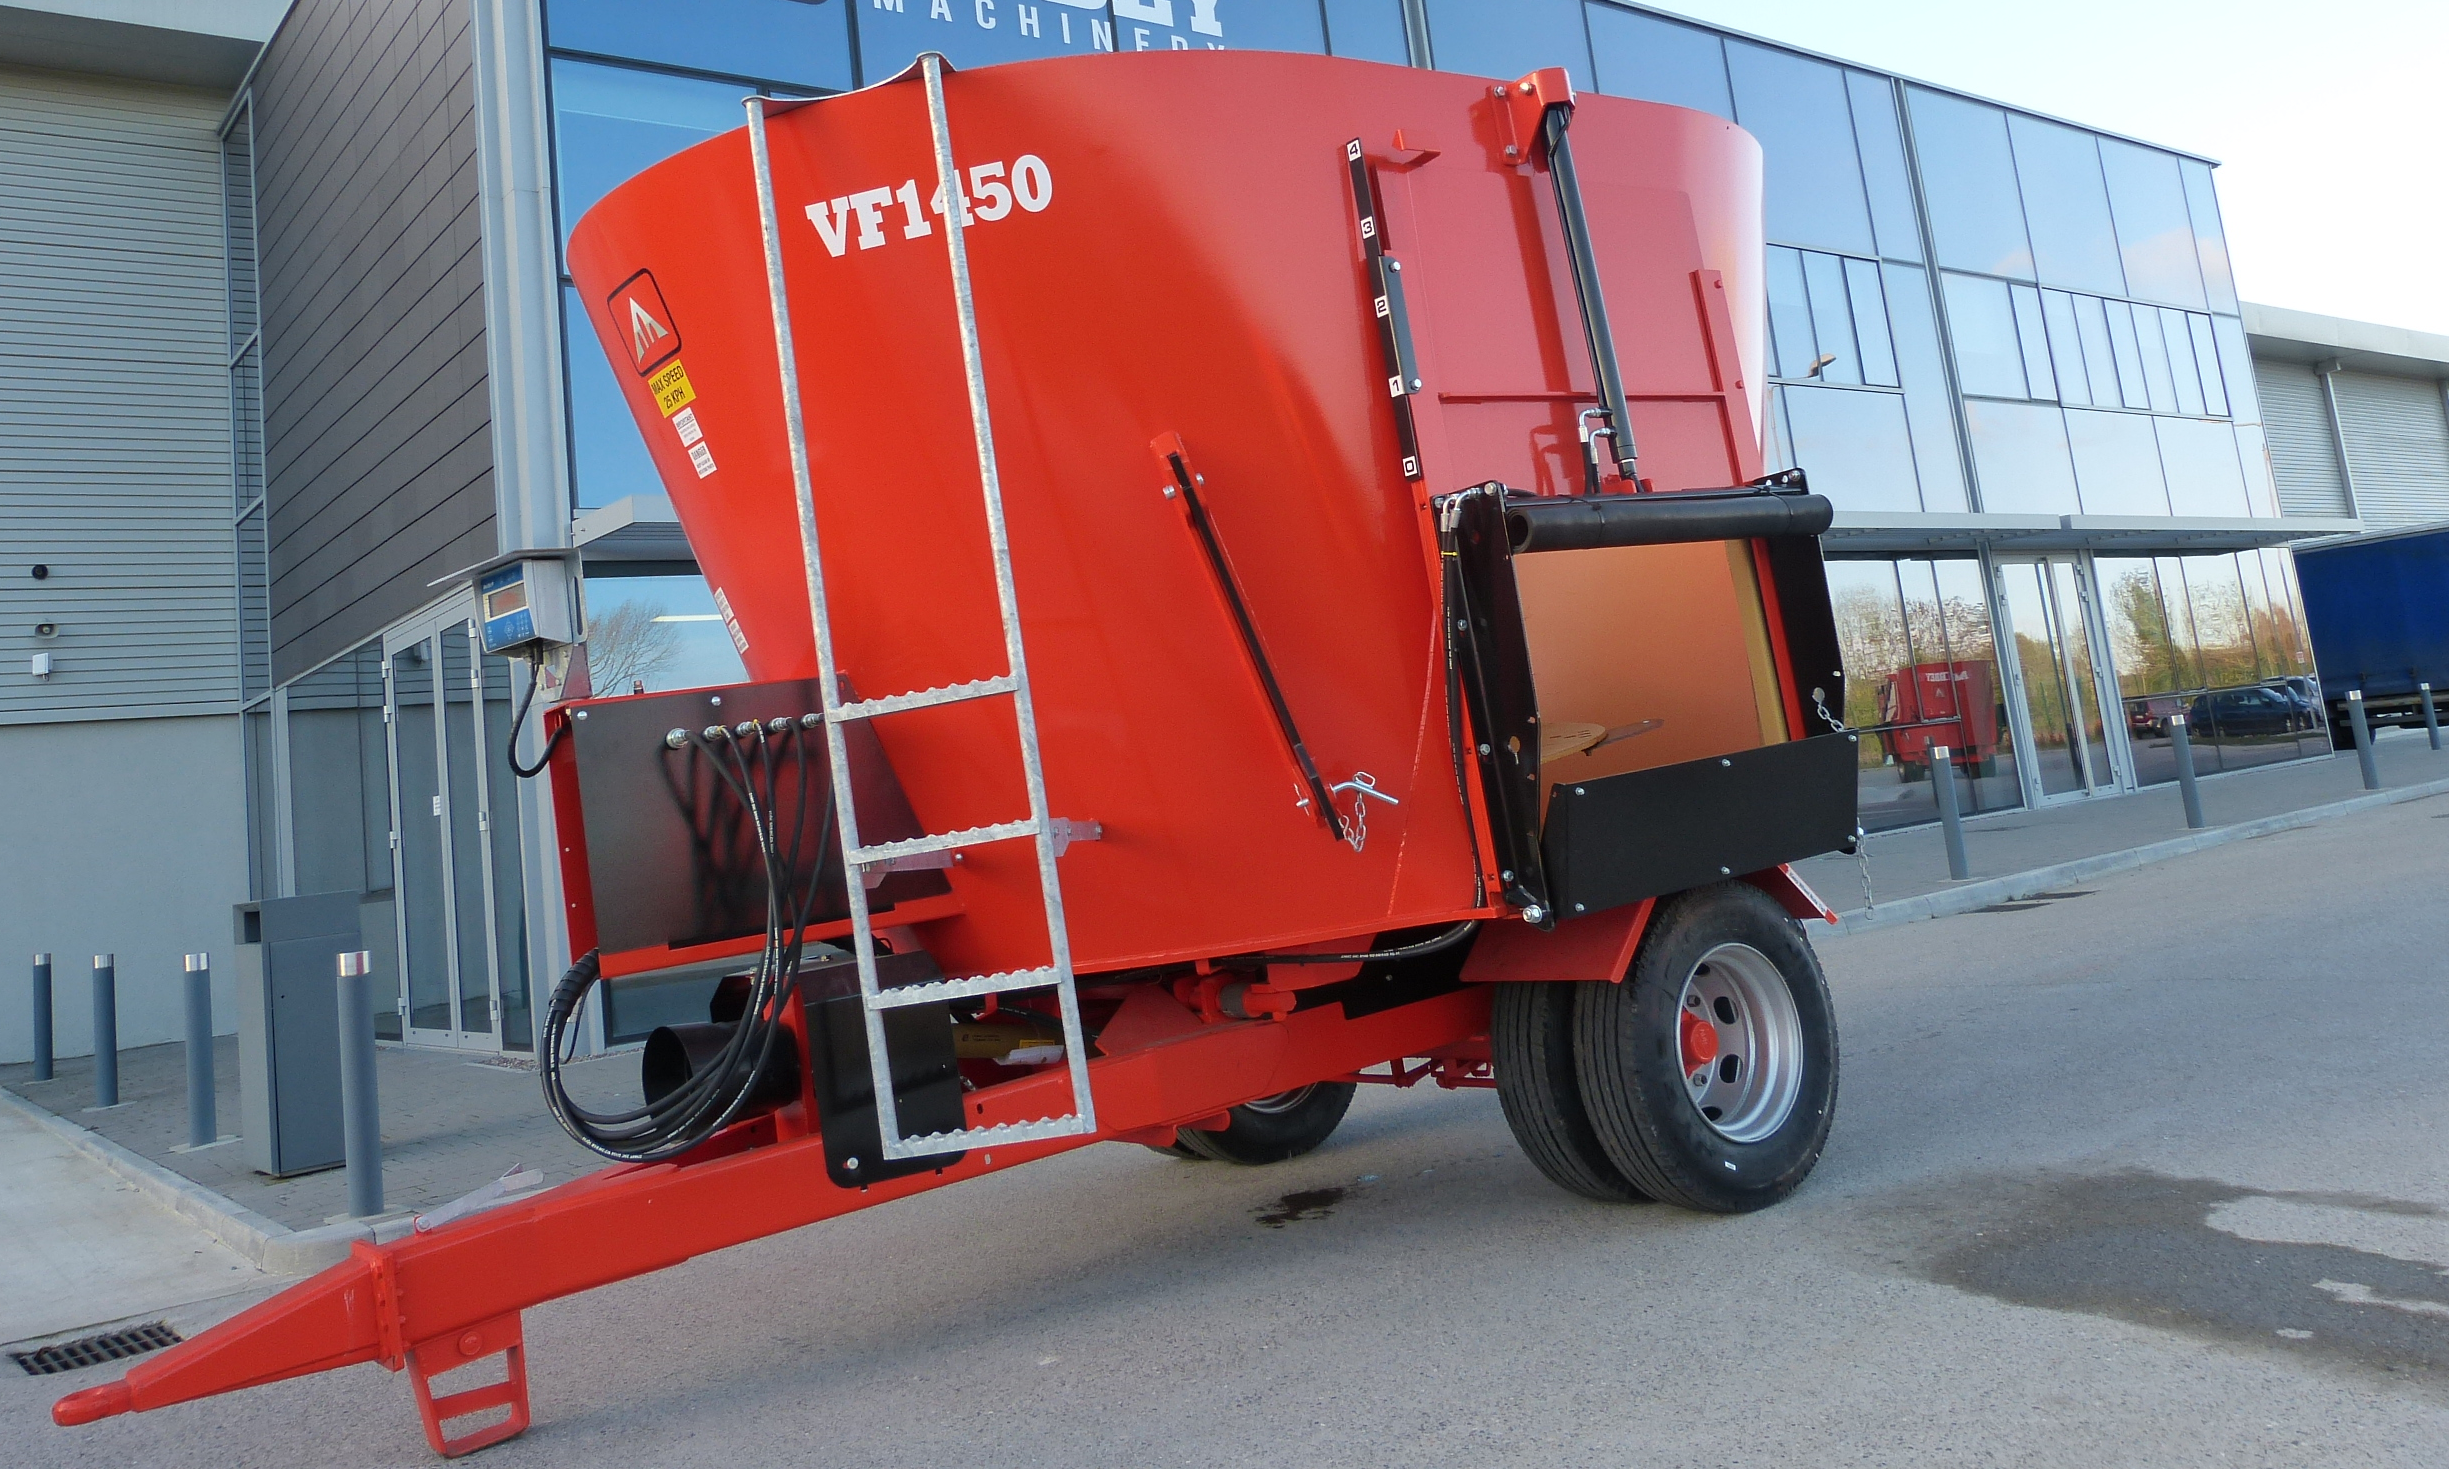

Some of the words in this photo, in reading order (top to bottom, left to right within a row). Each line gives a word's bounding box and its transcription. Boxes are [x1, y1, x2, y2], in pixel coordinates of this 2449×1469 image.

[873, 0, 1225, 52] ACHINE
[1349, 144, 1359, 156] 4
[805, 154, 1053, 258] VF1450
[1363, 221, 1372, 234] 3
[1376, 299, 1386, 313] 2
[651, 377, 665, 395] MAX
[663, 365, 684, 387] SPEED
[1392, 379, 1400, 392] 1
[664, 396, 673, 410] 25
[671, 387, 686, 405] KPH
